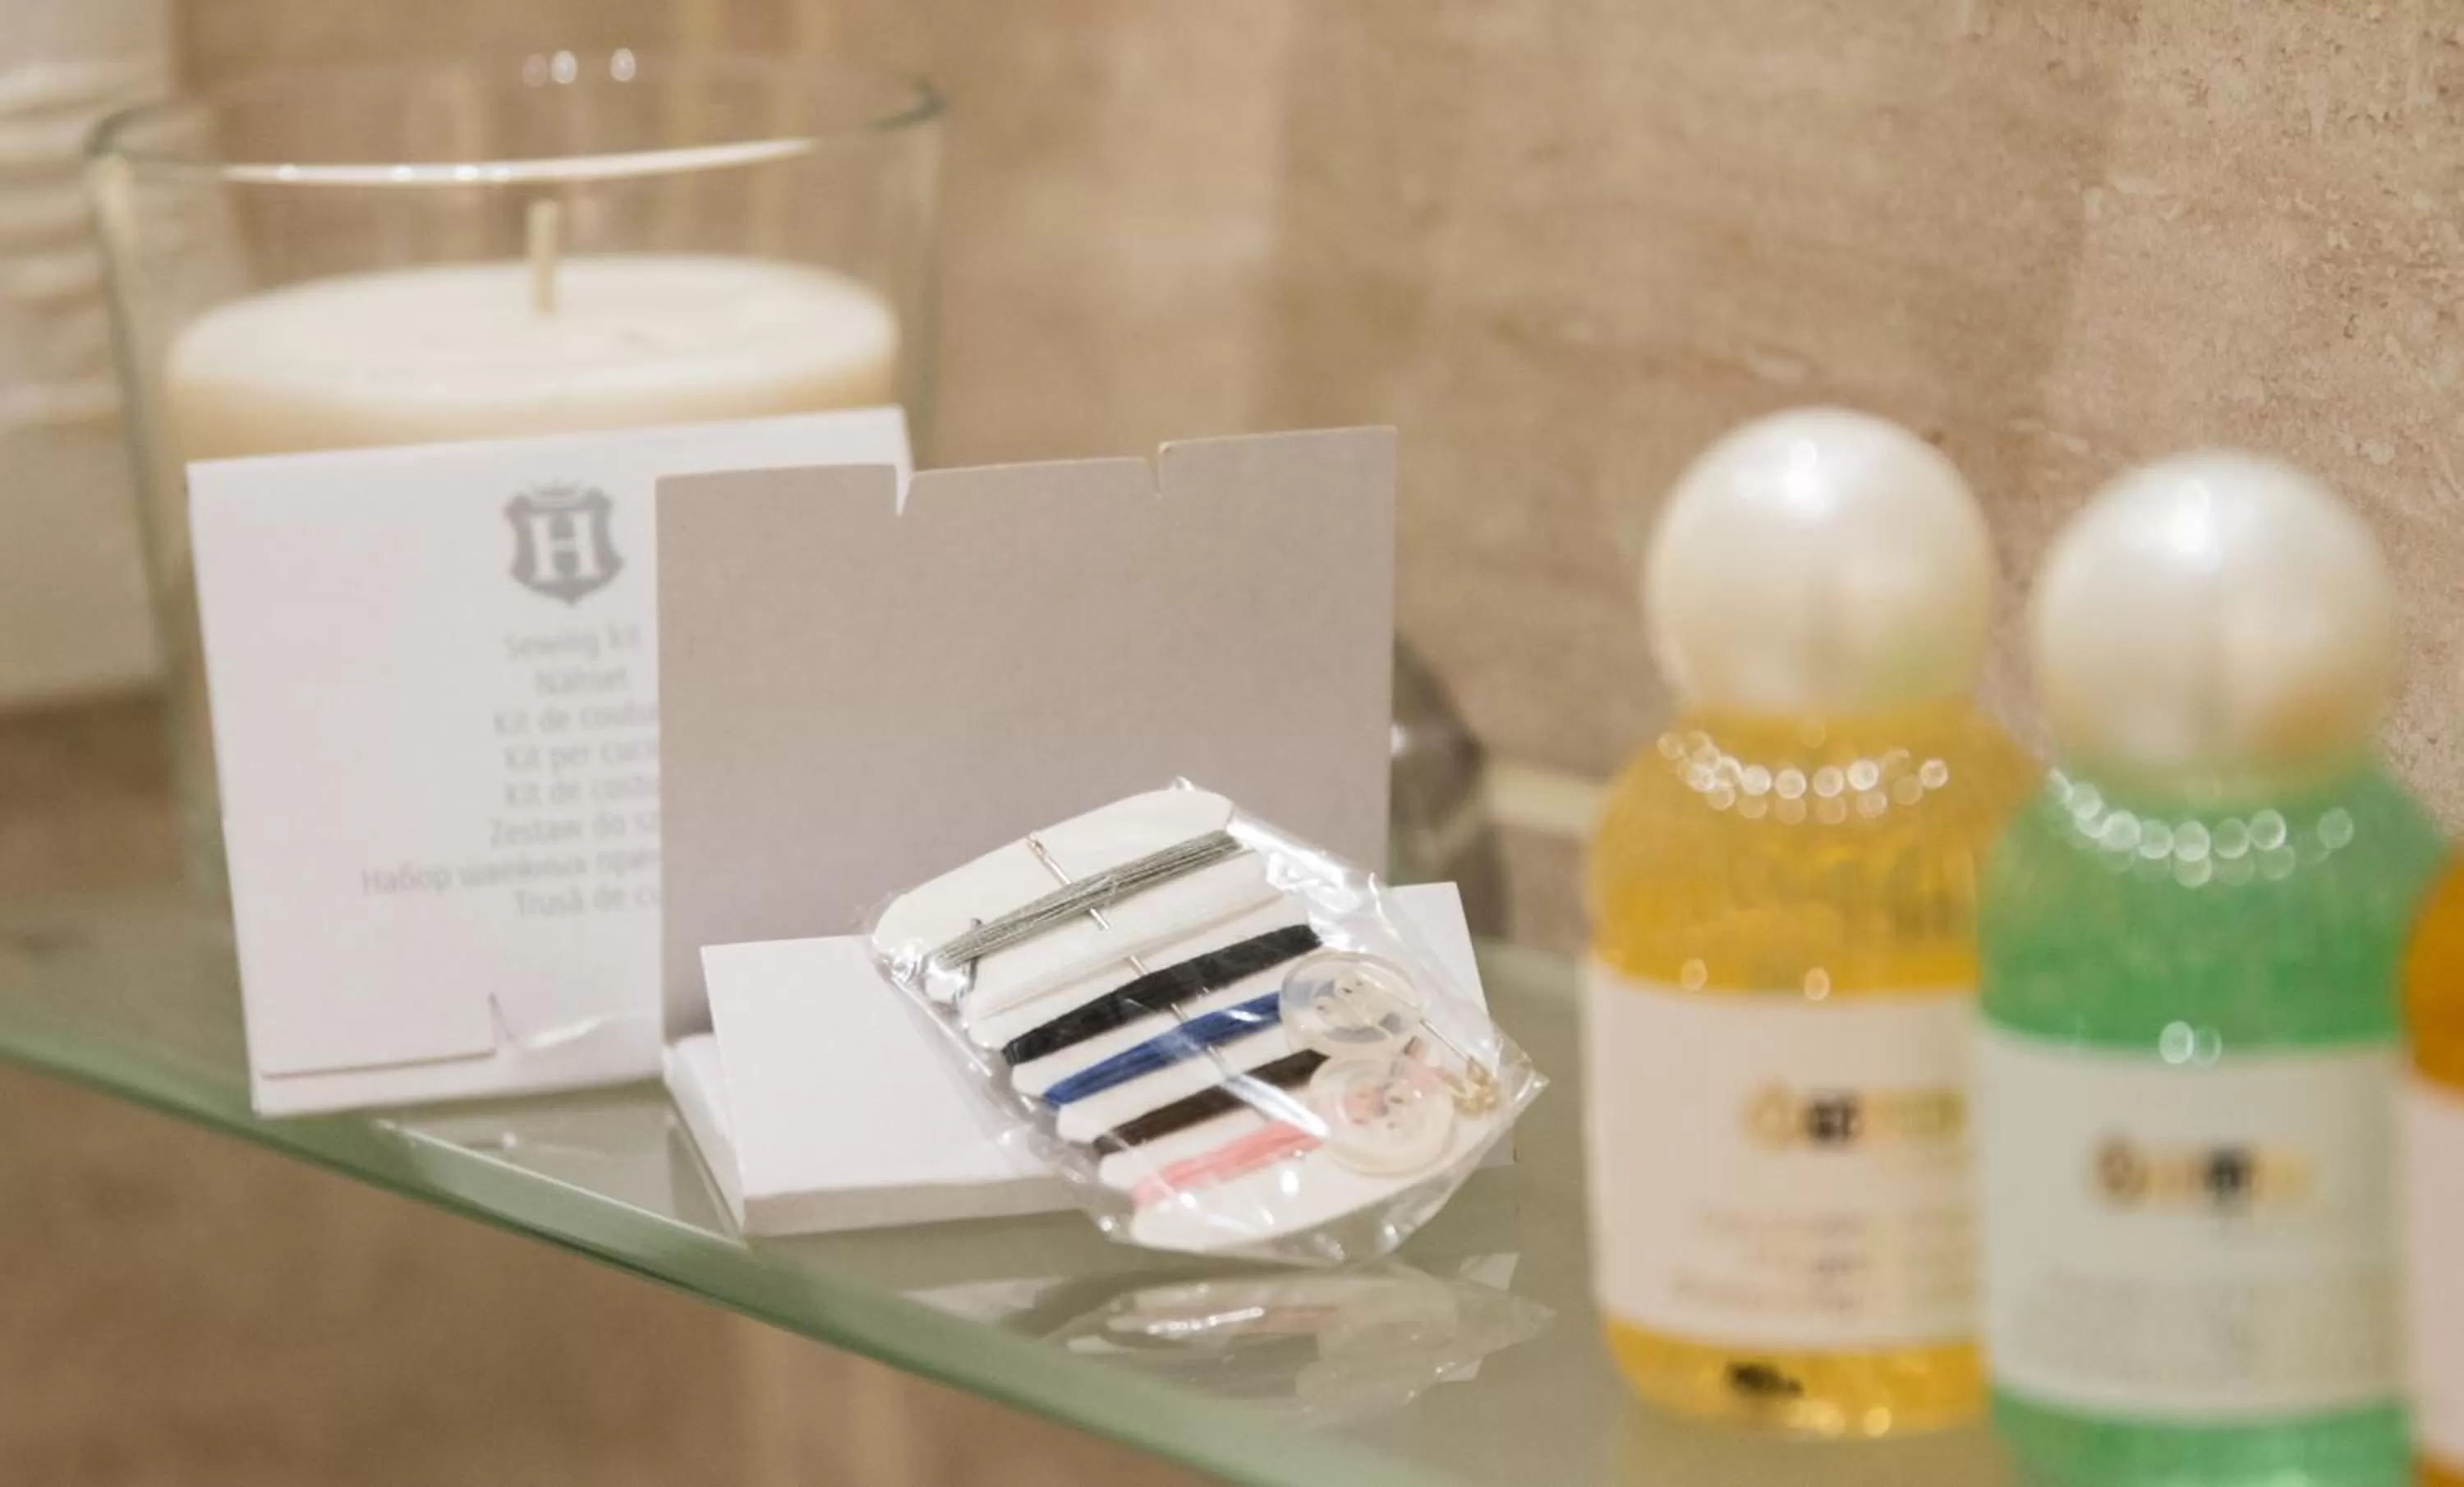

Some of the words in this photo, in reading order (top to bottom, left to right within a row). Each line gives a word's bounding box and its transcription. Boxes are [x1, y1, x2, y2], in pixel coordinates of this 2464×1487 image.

[528, 509, 603, 582] H
[503, 631, 600, 661] Sewing
[607, 622, 642, 651] kit
[493, 710, 530, 735] Kit
[538, 707, 570, 733] de
[503, 745, 540, 771] Kit
[549, 744, 590, 774] per
[503, 781, 541, 807] Kit
[549, 779, 581, 804] de
[490, 818, 582, 848] Zestaw
[591, 811, 626, 837] do
[361, 861, 453, 895] Набор
[591, 885, 626, 911] de
